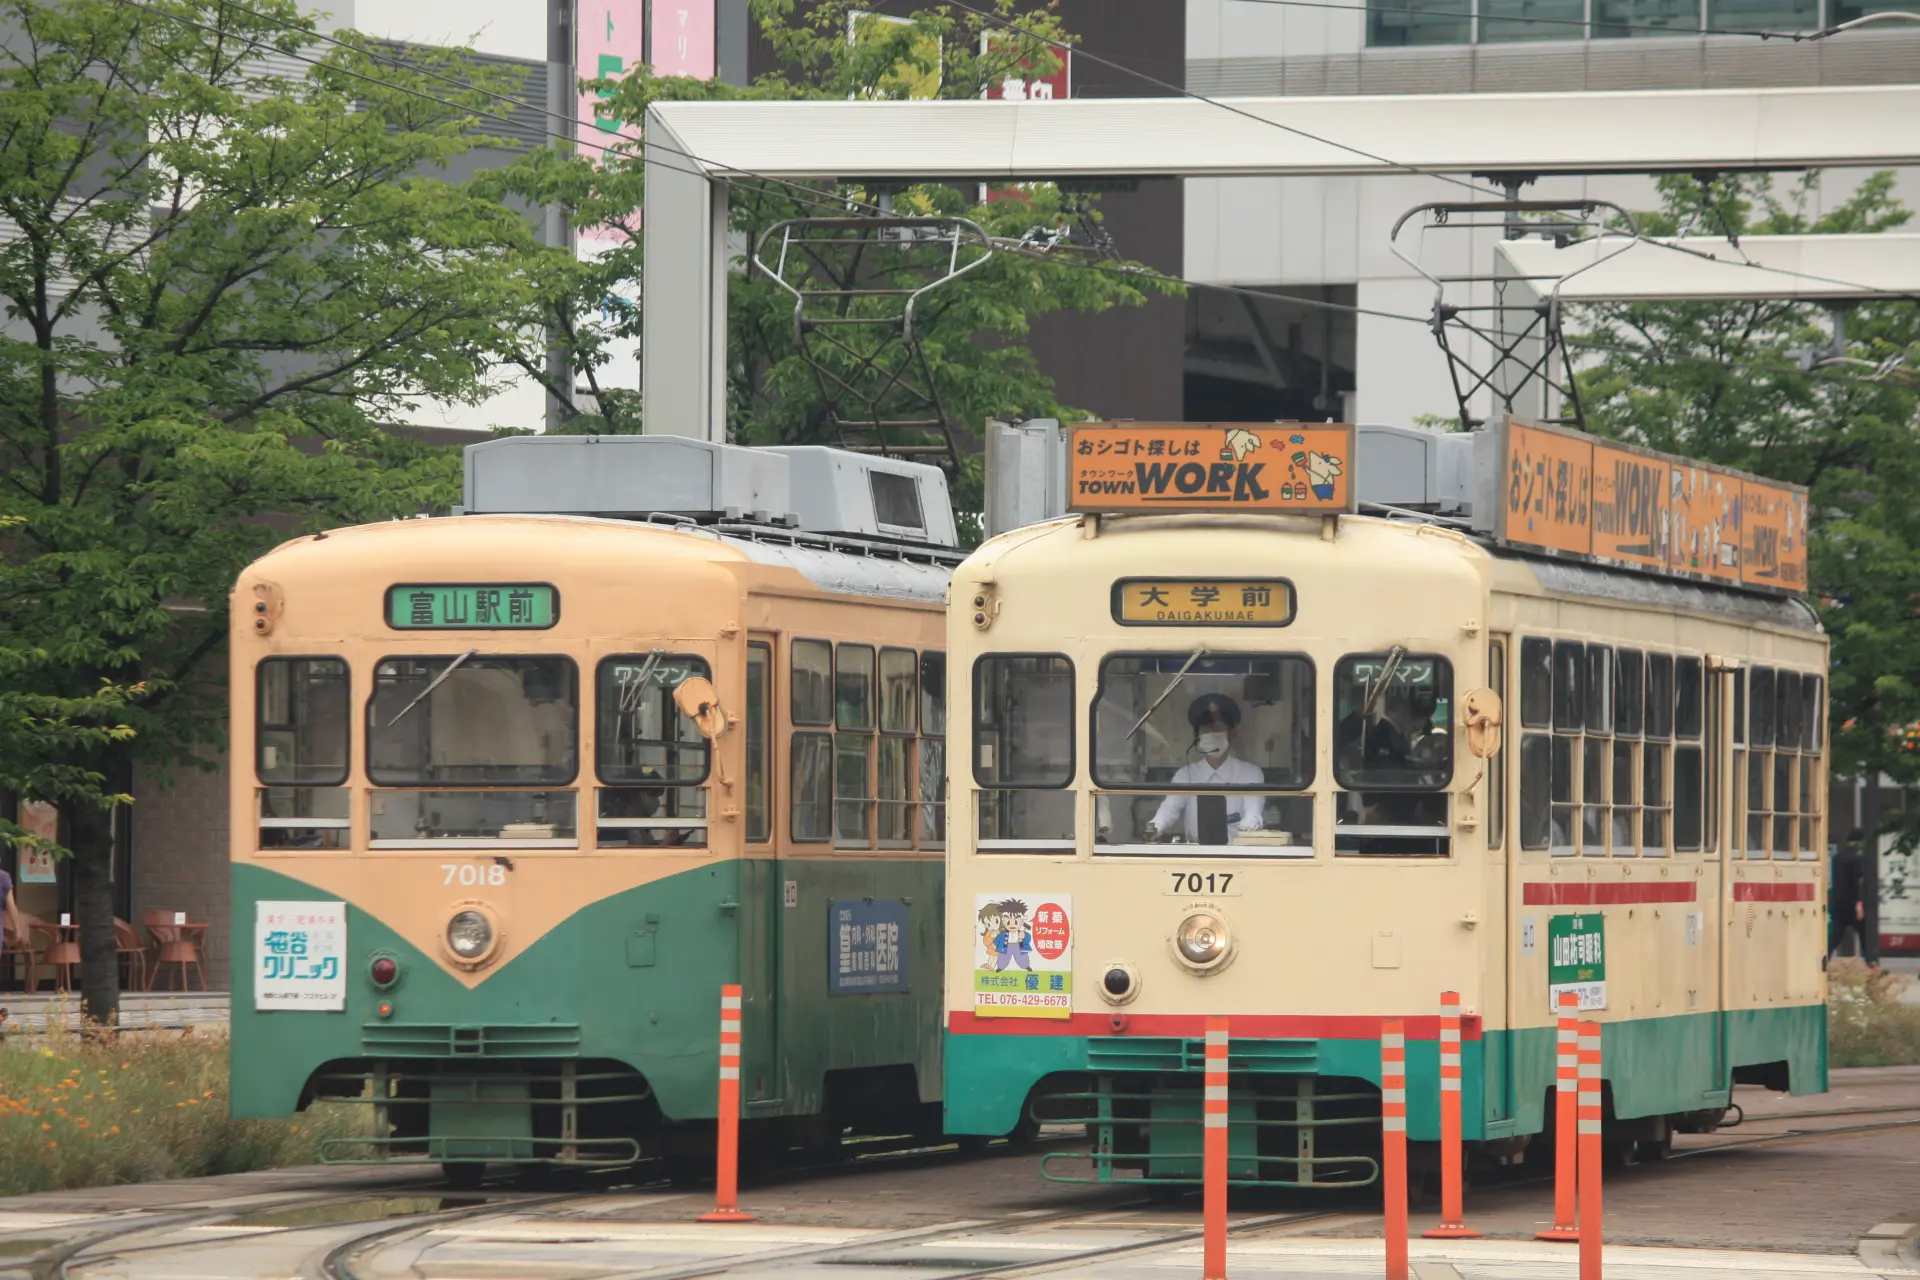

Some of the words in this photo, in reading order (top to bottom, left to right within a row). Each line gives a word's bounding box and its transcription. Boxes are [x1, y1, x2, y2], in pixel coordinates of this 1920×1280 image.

[1077, 439, 1200, 456] おシゴト探しは
[1079, 480, 1135, 495] TOWN
[1134, 462, 1269, 501] WORK
[1080, 470, 1134, 479] タウンワーク
[1614, 459, 1665, 557] WORK
[1140, 586, 1271, 607] 大学前
[410, 588, 534, 624] 富山駅前
[1157, 611, 1254, 620] DAIGAKUMAE
[614, 666, 688, 684] ワンマン
[1355, 665, 1431, 682] ワンマン
[441, 864, 506, 886] 7018
[1171, 873, 1234, 893] 7017
[1038, 911, 1063, 923] 新築
[1035, 927, 1065, 935] リフォーム
[264, 931, 308, 955] 笹谷
[263, 956, 339, 980] クリニック
[981, 976, 1018, 987] 株式会社
[1025, 974, 1063, 990] 優建
[978, 994, 997, 1004] TEL
[1000, 995, 1067, 1006] 076-429-6678
